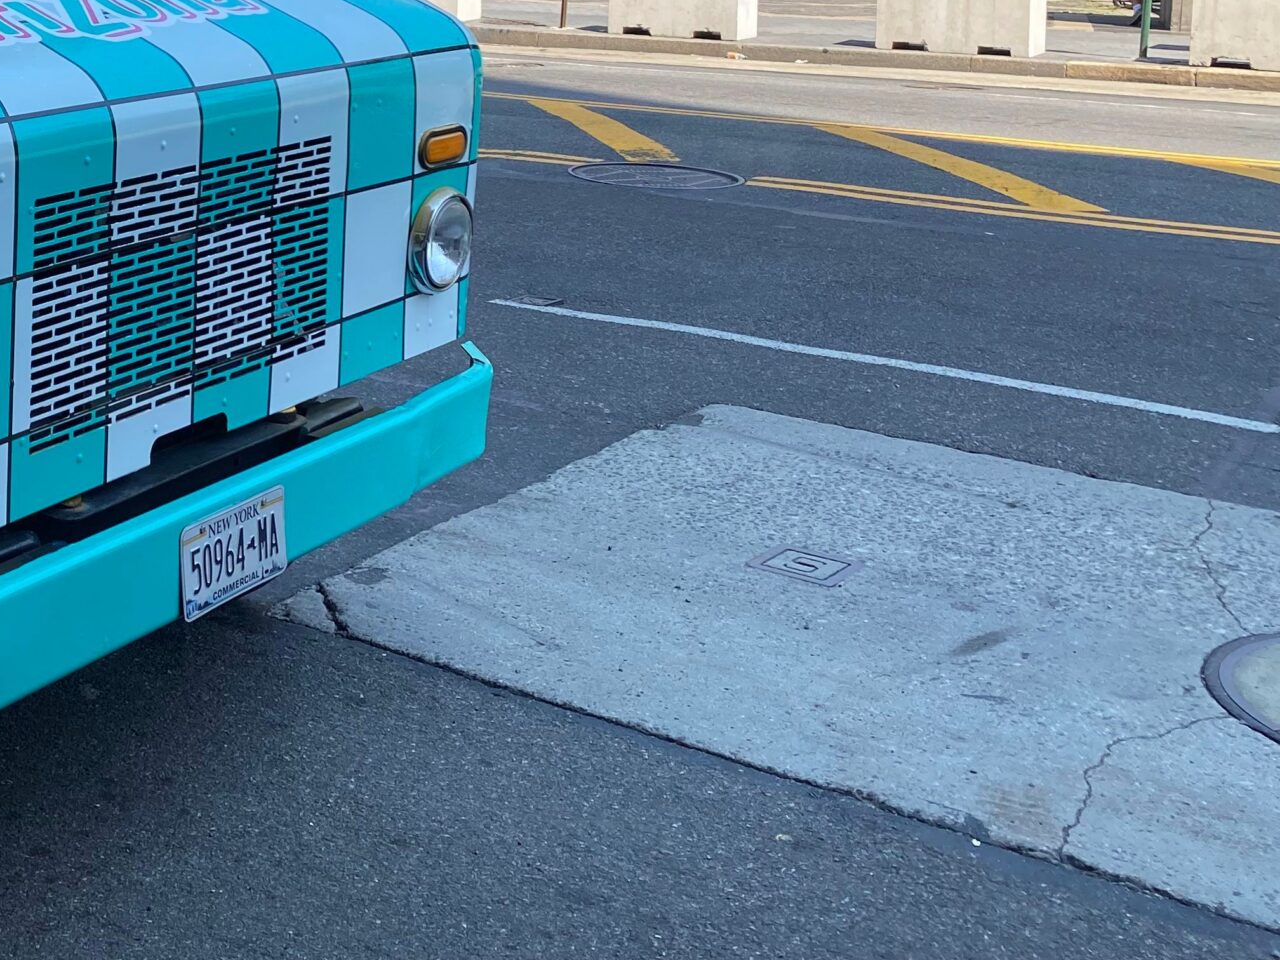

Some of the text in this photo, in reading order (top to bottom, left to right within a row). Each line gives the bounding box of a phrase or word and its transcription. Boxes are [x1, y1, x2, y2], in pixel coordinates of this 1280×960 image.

[207, 503, 260, 539] NEW YORK
[191, 525, 246, 597] 50964
[783, 556, 828, 573] S
[212, 569, 260, 601] COMMERCIAL
